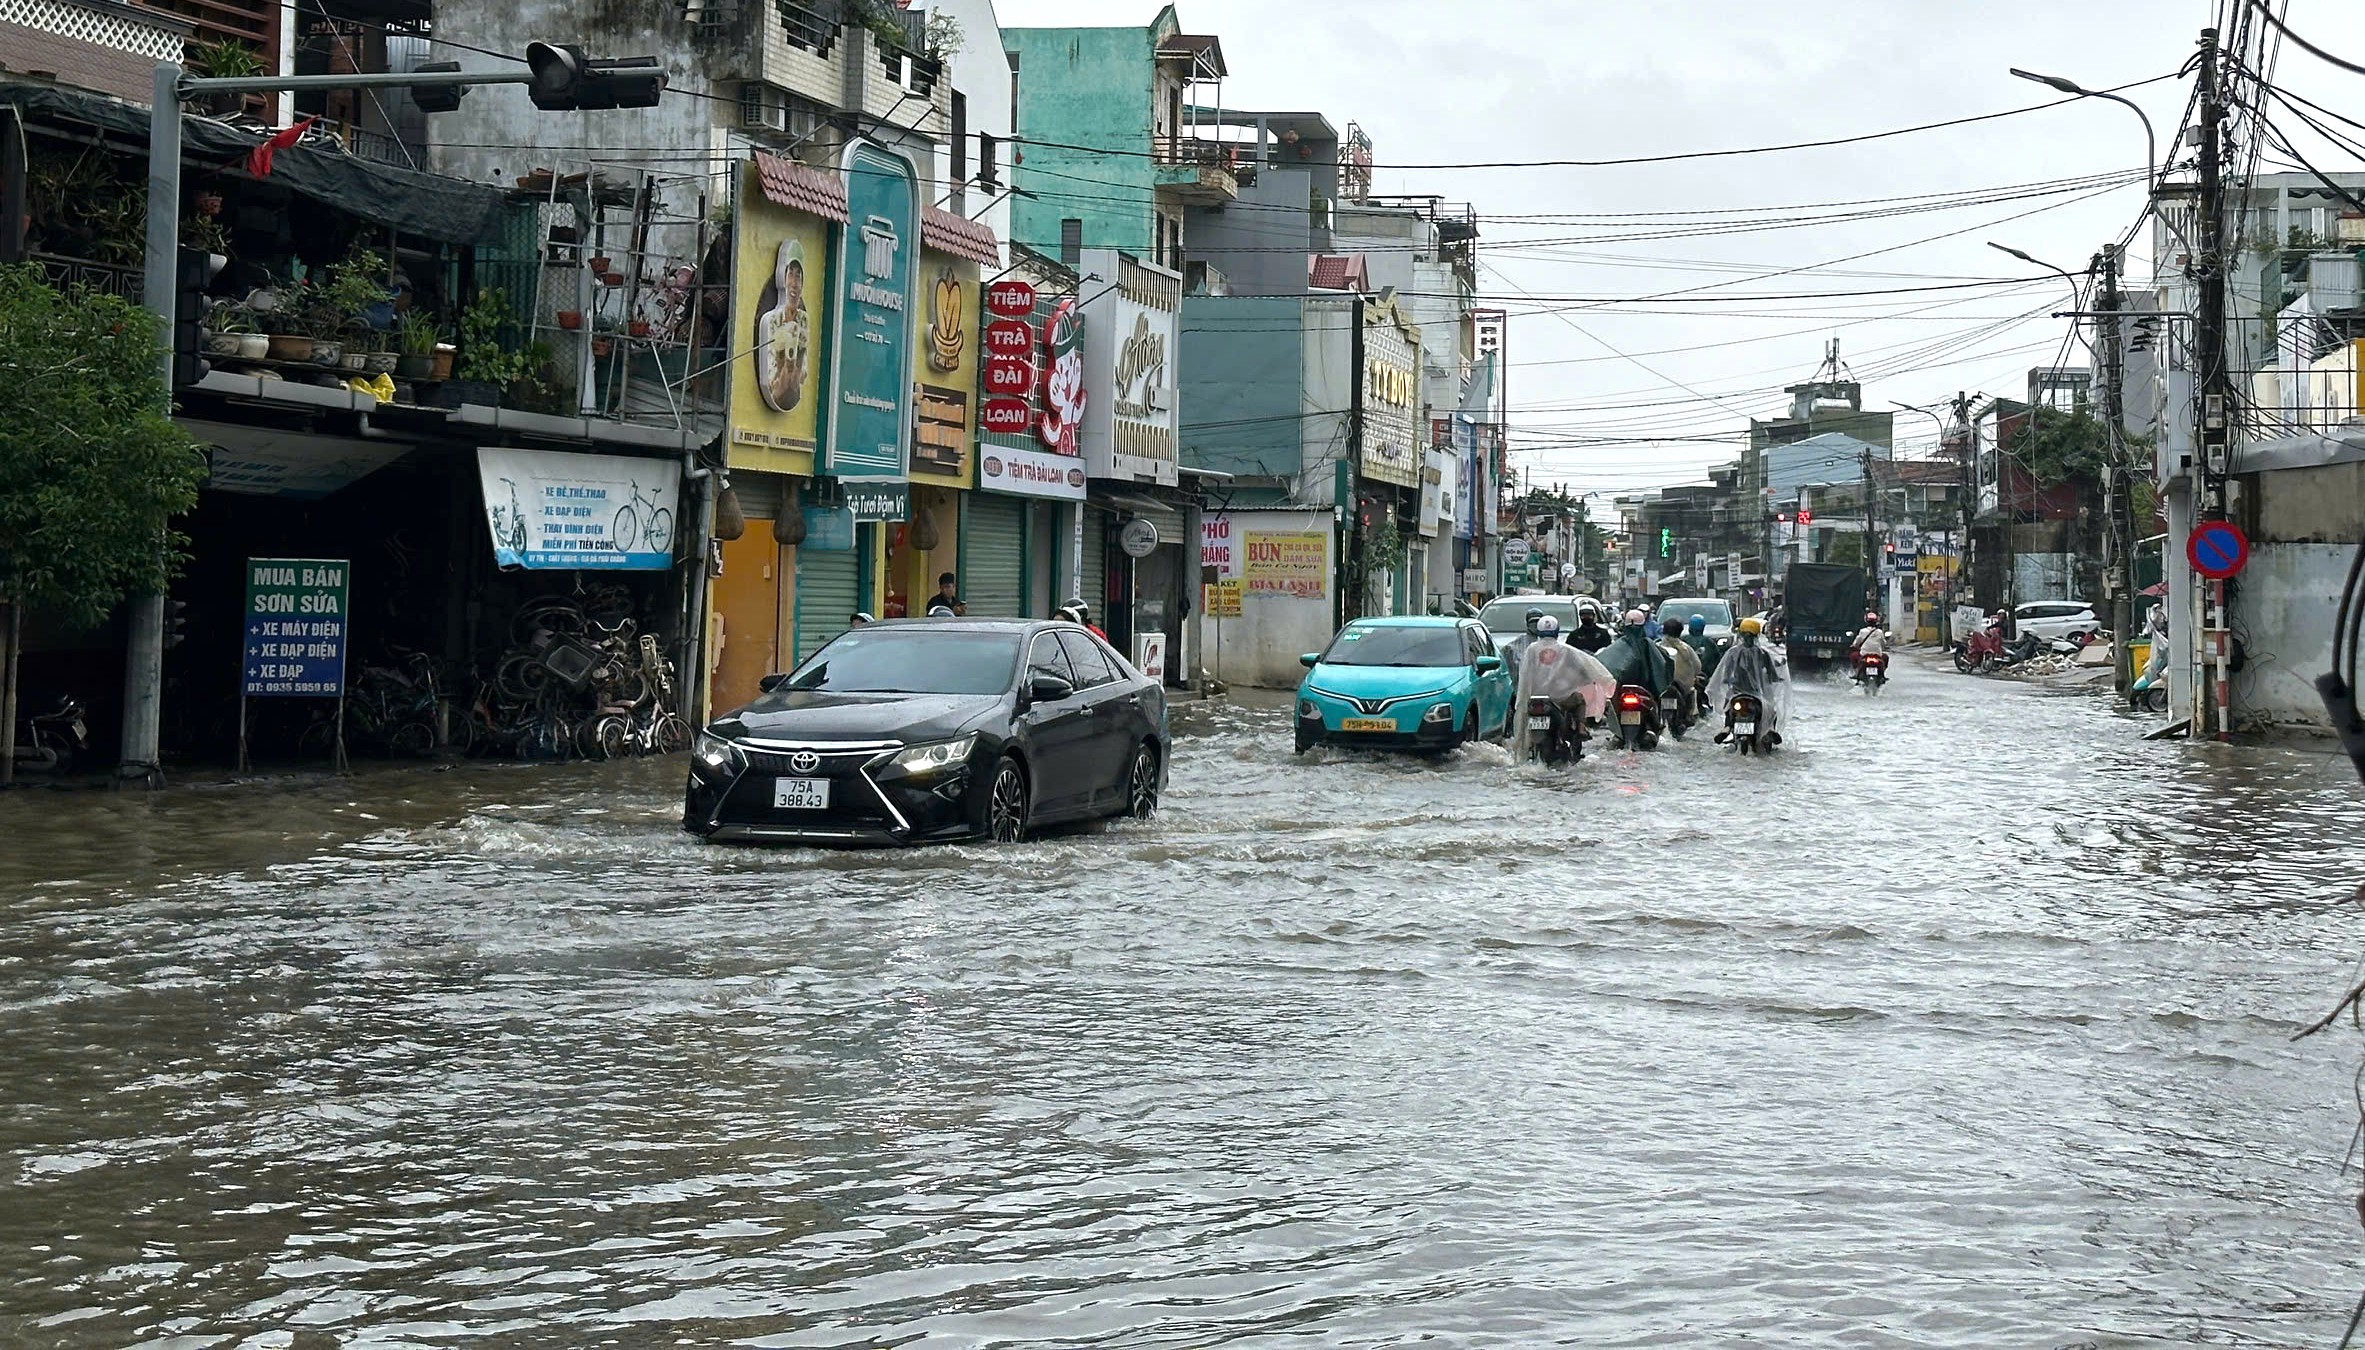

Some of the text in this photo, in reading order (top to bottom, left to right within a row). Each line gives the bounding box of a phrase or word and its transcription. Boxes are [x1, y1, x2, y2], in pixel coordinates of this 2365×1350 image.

[991, 288, 1031, 309] TIỆM
[991, 327, 1026, 345] TRÀ
[993, 366, 1022, 384] ĐÀI
[986, 408, 1025, 423] LOAN
[545, 486, 555, 497] XE
[544, 506, 554, 516] XE
[860, 494, 877, 513] Tươi
[877, 494, 895, 518] Đậm
[896, 495, 904, 518] Vị
[595, 538, 614, 550] CÔNG
[1248, 537, 1281, 562] BÚN
[254, 566, 342, 587] MUA BÁN
[254, 590, 338, 613] SƠN SỬA
[262, 620, 340, 640] XE MÁY ĐIỆN
[261, 641, 336, 660] XE ĐẠP ĐIỆN
[260, 664, 304, 681] XE ĐẠP
[790, 780, 812, 793] 75A
[779, 794, 822, 807] 388.43
